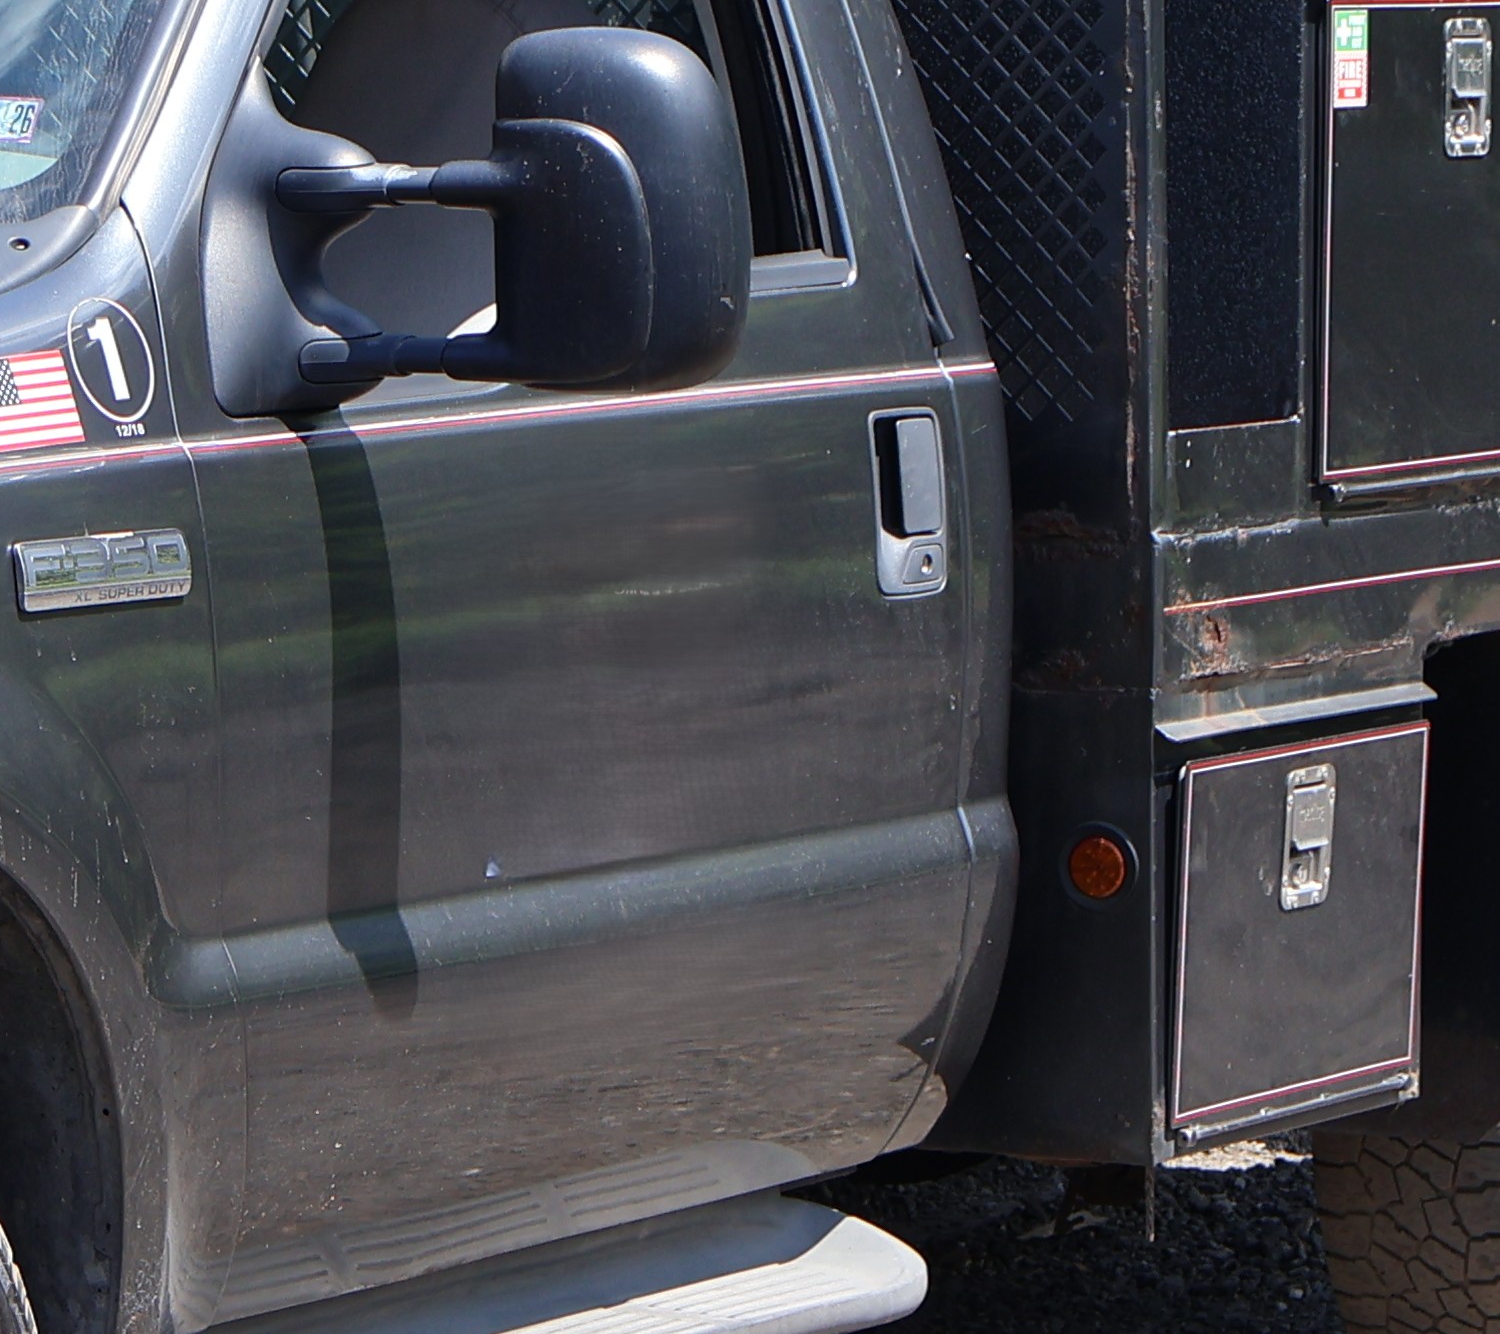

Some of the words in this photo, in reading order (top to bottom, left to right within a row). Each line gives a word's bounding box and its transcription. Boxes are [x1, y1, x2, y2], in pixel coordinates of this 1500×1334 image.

[9, 103, 35, 135] 26
[86, 317, 131, 401] 1
[75, 591, 92, 603] XL
[98, 585, 144, 601] SUPER
[148, 581, 187, 596] DUTY
